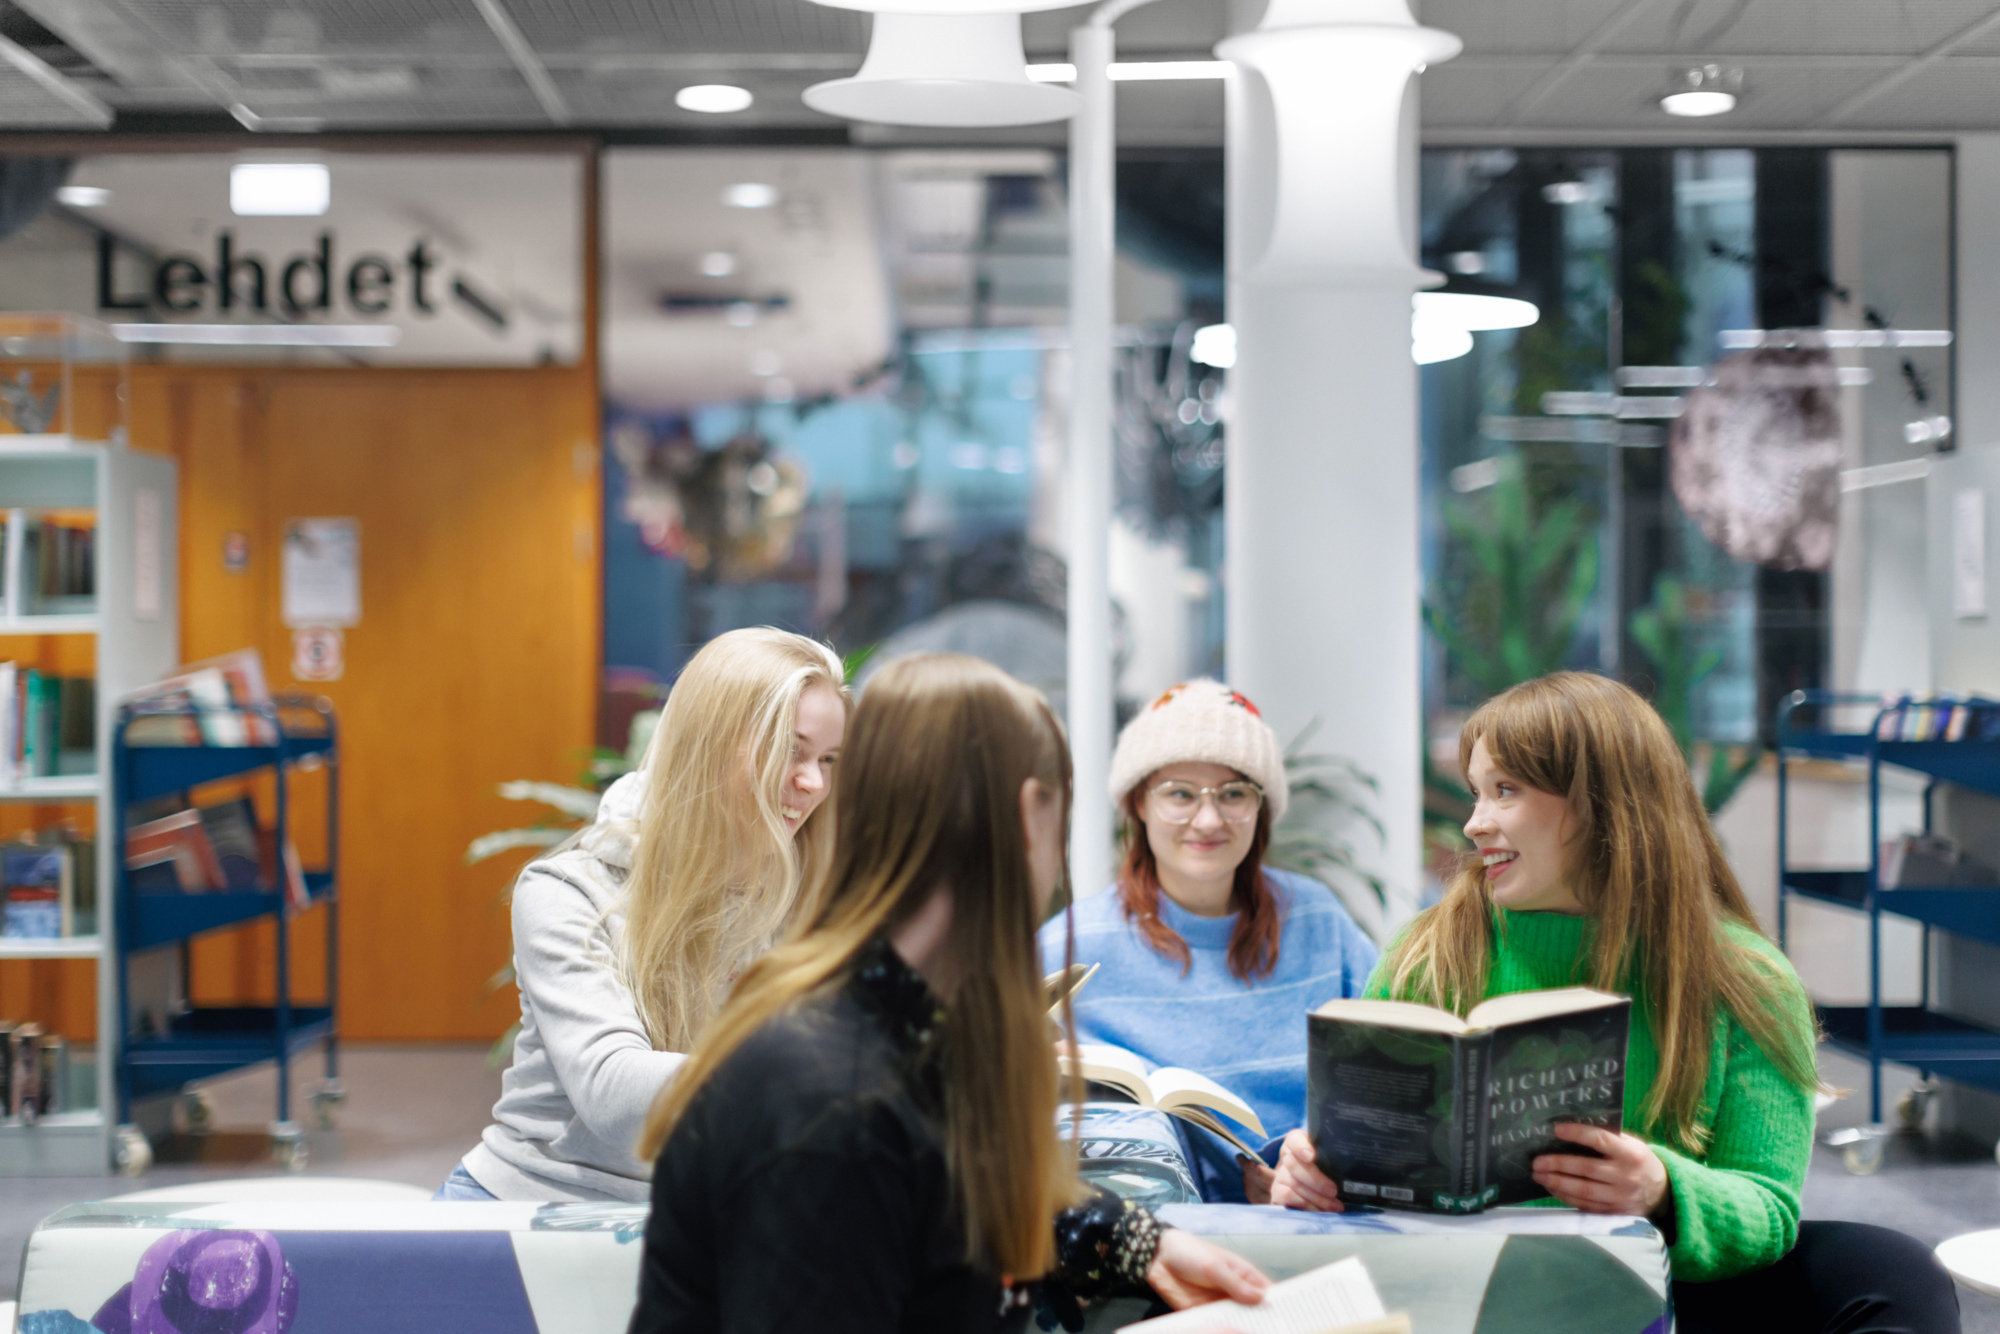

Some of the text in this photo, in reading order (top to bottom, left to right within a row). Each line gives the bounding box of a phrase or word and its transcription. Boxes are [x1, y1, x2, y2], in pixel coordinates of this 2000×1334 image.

[98, 230, 436, 313] Lehdet
[1487, 1059, 1619, 1098] RICHARD
[1491, 1082, 1612, 1120] POWERS
